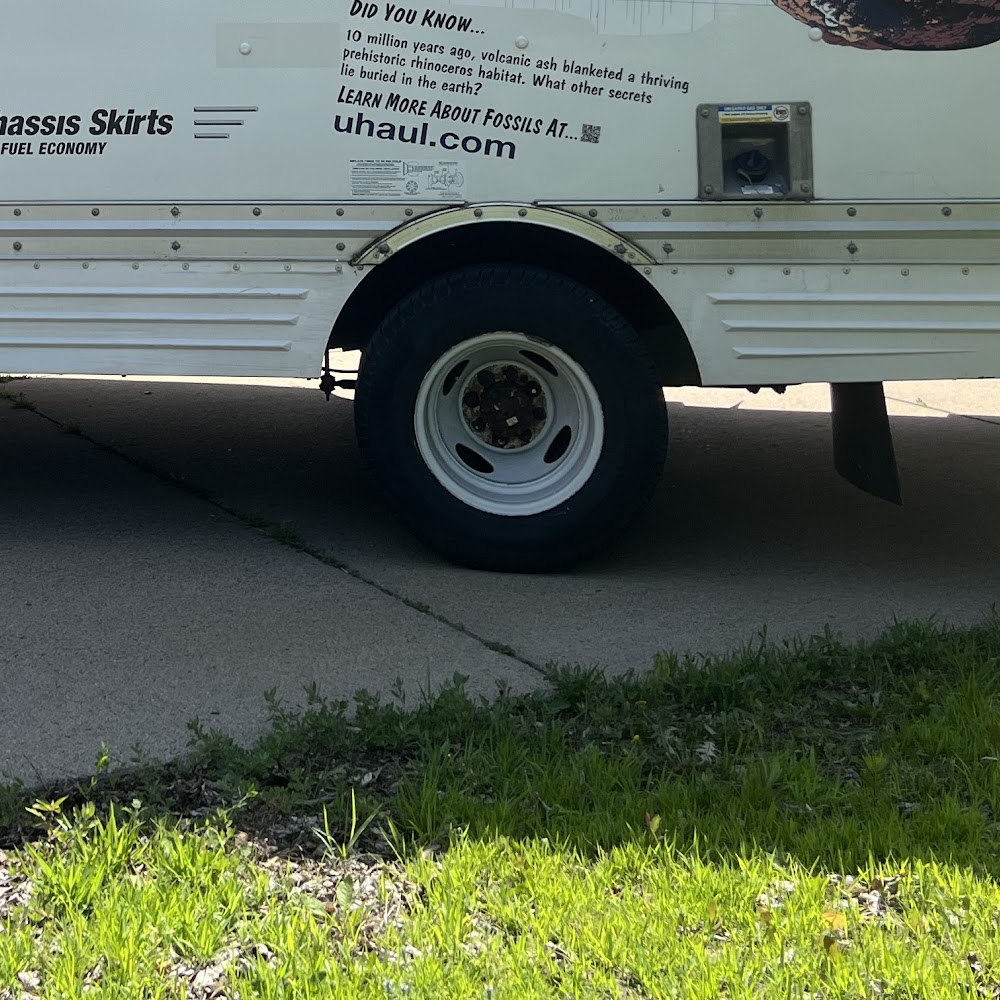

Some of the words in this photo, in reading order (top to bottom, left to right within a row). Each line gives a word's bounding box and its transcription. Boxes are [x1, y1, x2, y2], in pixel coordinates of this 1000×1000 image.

[350, 0, 378, 19] DID
[384, 3, 417, 24] YOU
[421, 8, 485, 34] KNOW...
[340, 63, 355, 77] lie
[359, 66, 397, 83] buried
[401, 72, 412, 85] in
[418, 74, 437, 89] the
[441, 81, 483, 95] earth?
[343, 47, 406, 67] prehistoric
[410, 56, 473, 77] rhinoceros
[478, 65, 526, 85] habitat.
[533, 73, 566, 91] What
[571, 80, 604, 96] other
[608, 88, 652, 104] secrets
[346, 29, 362, 42] 10
[367, 33, 408, 48] million
[413, 41, 445, 54] years
[450, 47, 475, 61] ago,
[481, 50, 531, 67] volcanic
[535, 57, 557, 71] ash
[563, 59, 623, 81] blanketed
[628, 73, 635, 83] a
[641, 71, 689, 94] thriving
[88, 109, 174, 136] Skirts
[337, 85, 383, 109] LEARN
[385, 92, 427, 116] MORE
[430, 100, 481, 124] ABOUT
[482, 108, 543, 134] FOSSILS
[545, 118, 578, 140] AT...
[0, 142, 34, 155] FUEL
[38, 141, 107, 155] ECONOMY
[334, 112, 516, 160] uhaul.com
